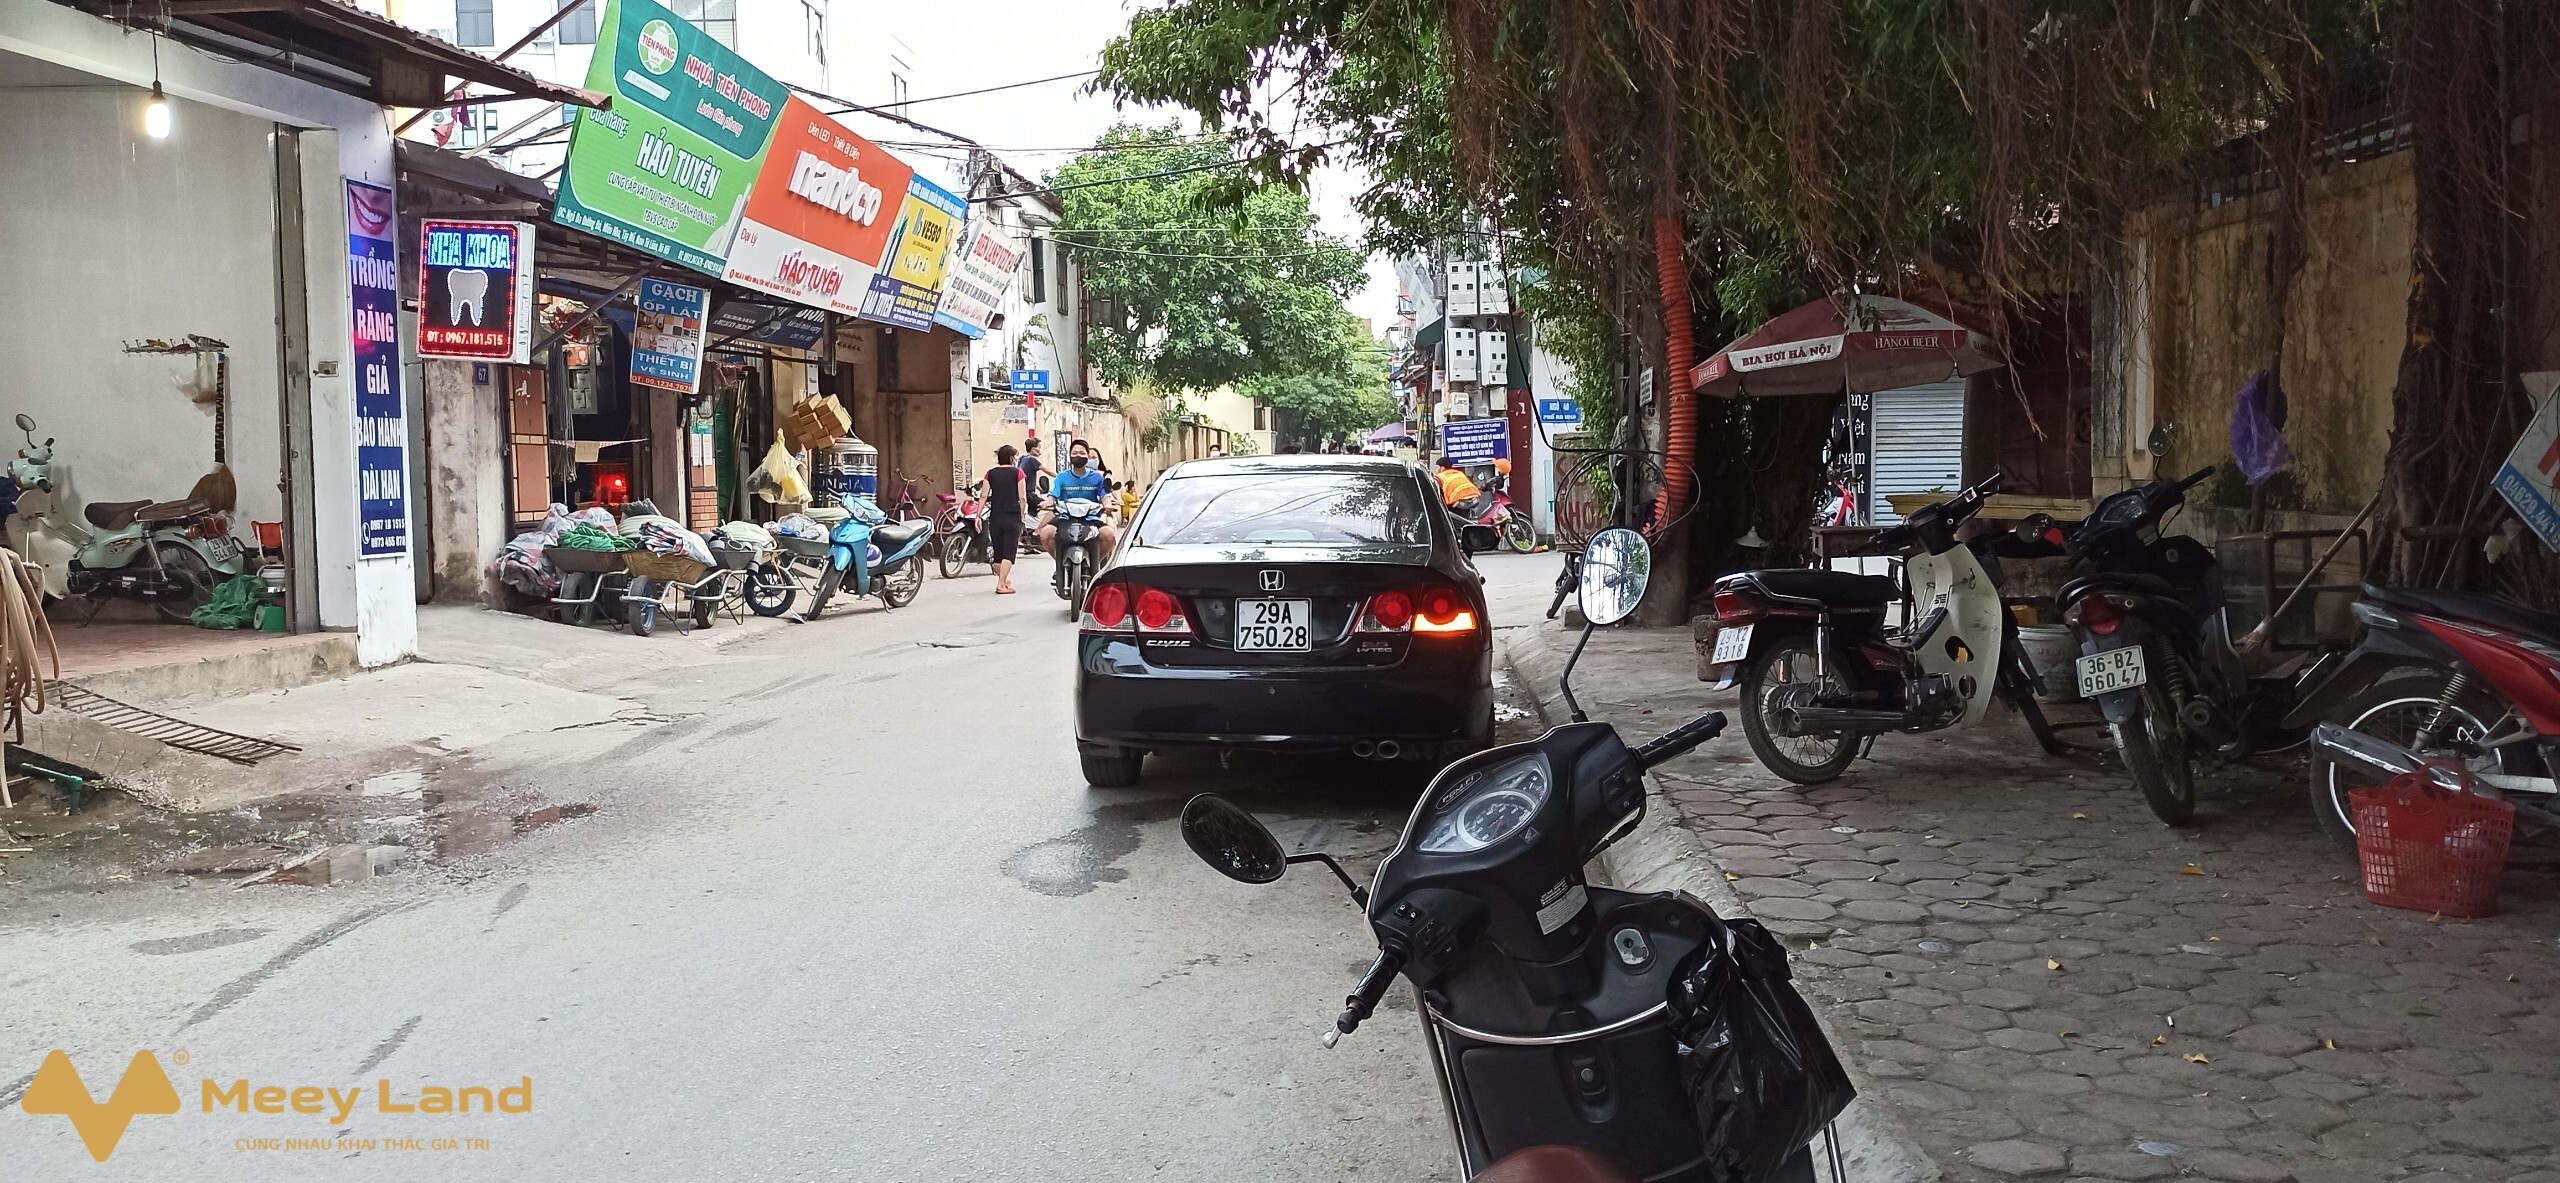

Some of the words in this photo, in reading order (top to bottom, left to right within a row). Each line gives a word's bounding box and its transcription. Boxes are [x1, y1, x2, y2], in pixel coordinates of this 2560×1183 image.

[684, 54, 713, 88] NHỰA
[739, 87, 771, 120] PHONG
[635, 127, 675, 178] HẢO
[672, 148, 722, 200] TUYÊN
[427, 232, 463, 267] NHA
[465, 233, 511, 269] KHOA
[350, 247, 395, 291] TRỒNG
[651, 283, 698, 303] GẠCH
[643, 299, 666, 312] ỐP
[670, 306, 702, 319] LÁT
[356, 304, 395, 343] RĂNG
[1874, 336, 1910, 349] HANOI
[1911, 336, 1941, 348] BEER
[637, 352, 677, 367] THIẾT
[680, 361, 693, 373] BỊ
[1741, 357, 1763, 368] BIA
[1765, 352, 1790, 364] HƠI
[1791, 348, 1808, 361] HÀ
[1810, 345, 1832, 357] NỘI
[366, 354, 390, 395] GIẢ
[478, 367, 486, 382] 67
[640, 365, 656, 375] VỆ
[659, 369, 689, 380] SINH
[356, 406, 376, 447] BẢO
[377, 411, 403, 447] HÀNH
[362, 463, 379, 500] DÀI
[381, 469, 400, 506] HẠN
[1254, 602, 1293, 624] 29A
[1240, 626, 1308, 648] 750.28
[1716, 645, 1744, 662] 9318
[2087, 651, 2134, 675] 36-B2
[2084, 666, 2140, 692] 960.47
